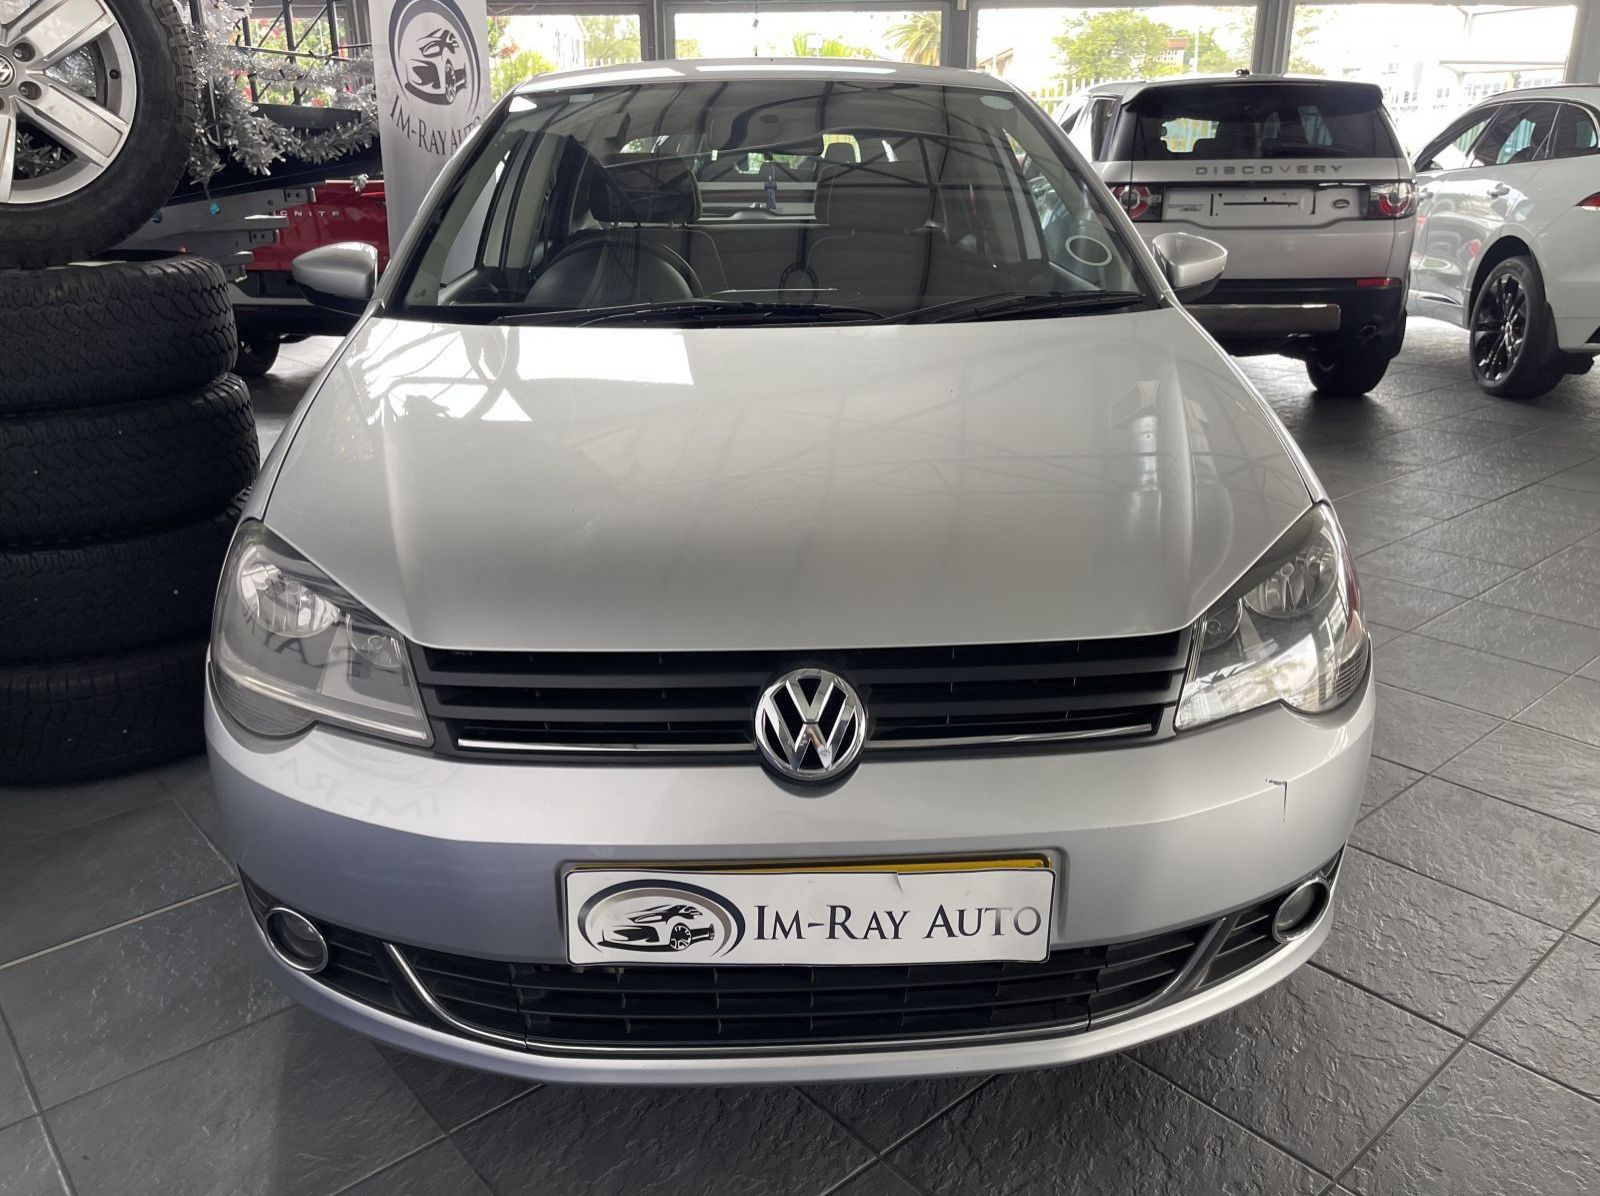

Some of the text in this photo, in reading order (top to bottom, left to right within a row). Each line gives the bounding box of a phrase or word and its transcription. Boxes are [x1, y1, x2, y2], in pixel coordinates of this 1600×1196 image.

[390, 95, 446, 156] IM-RAY
[1195, 164, 1343, 176] DISCOVERY
[753, 904, 1042, 940] IM-RAY AUTO
